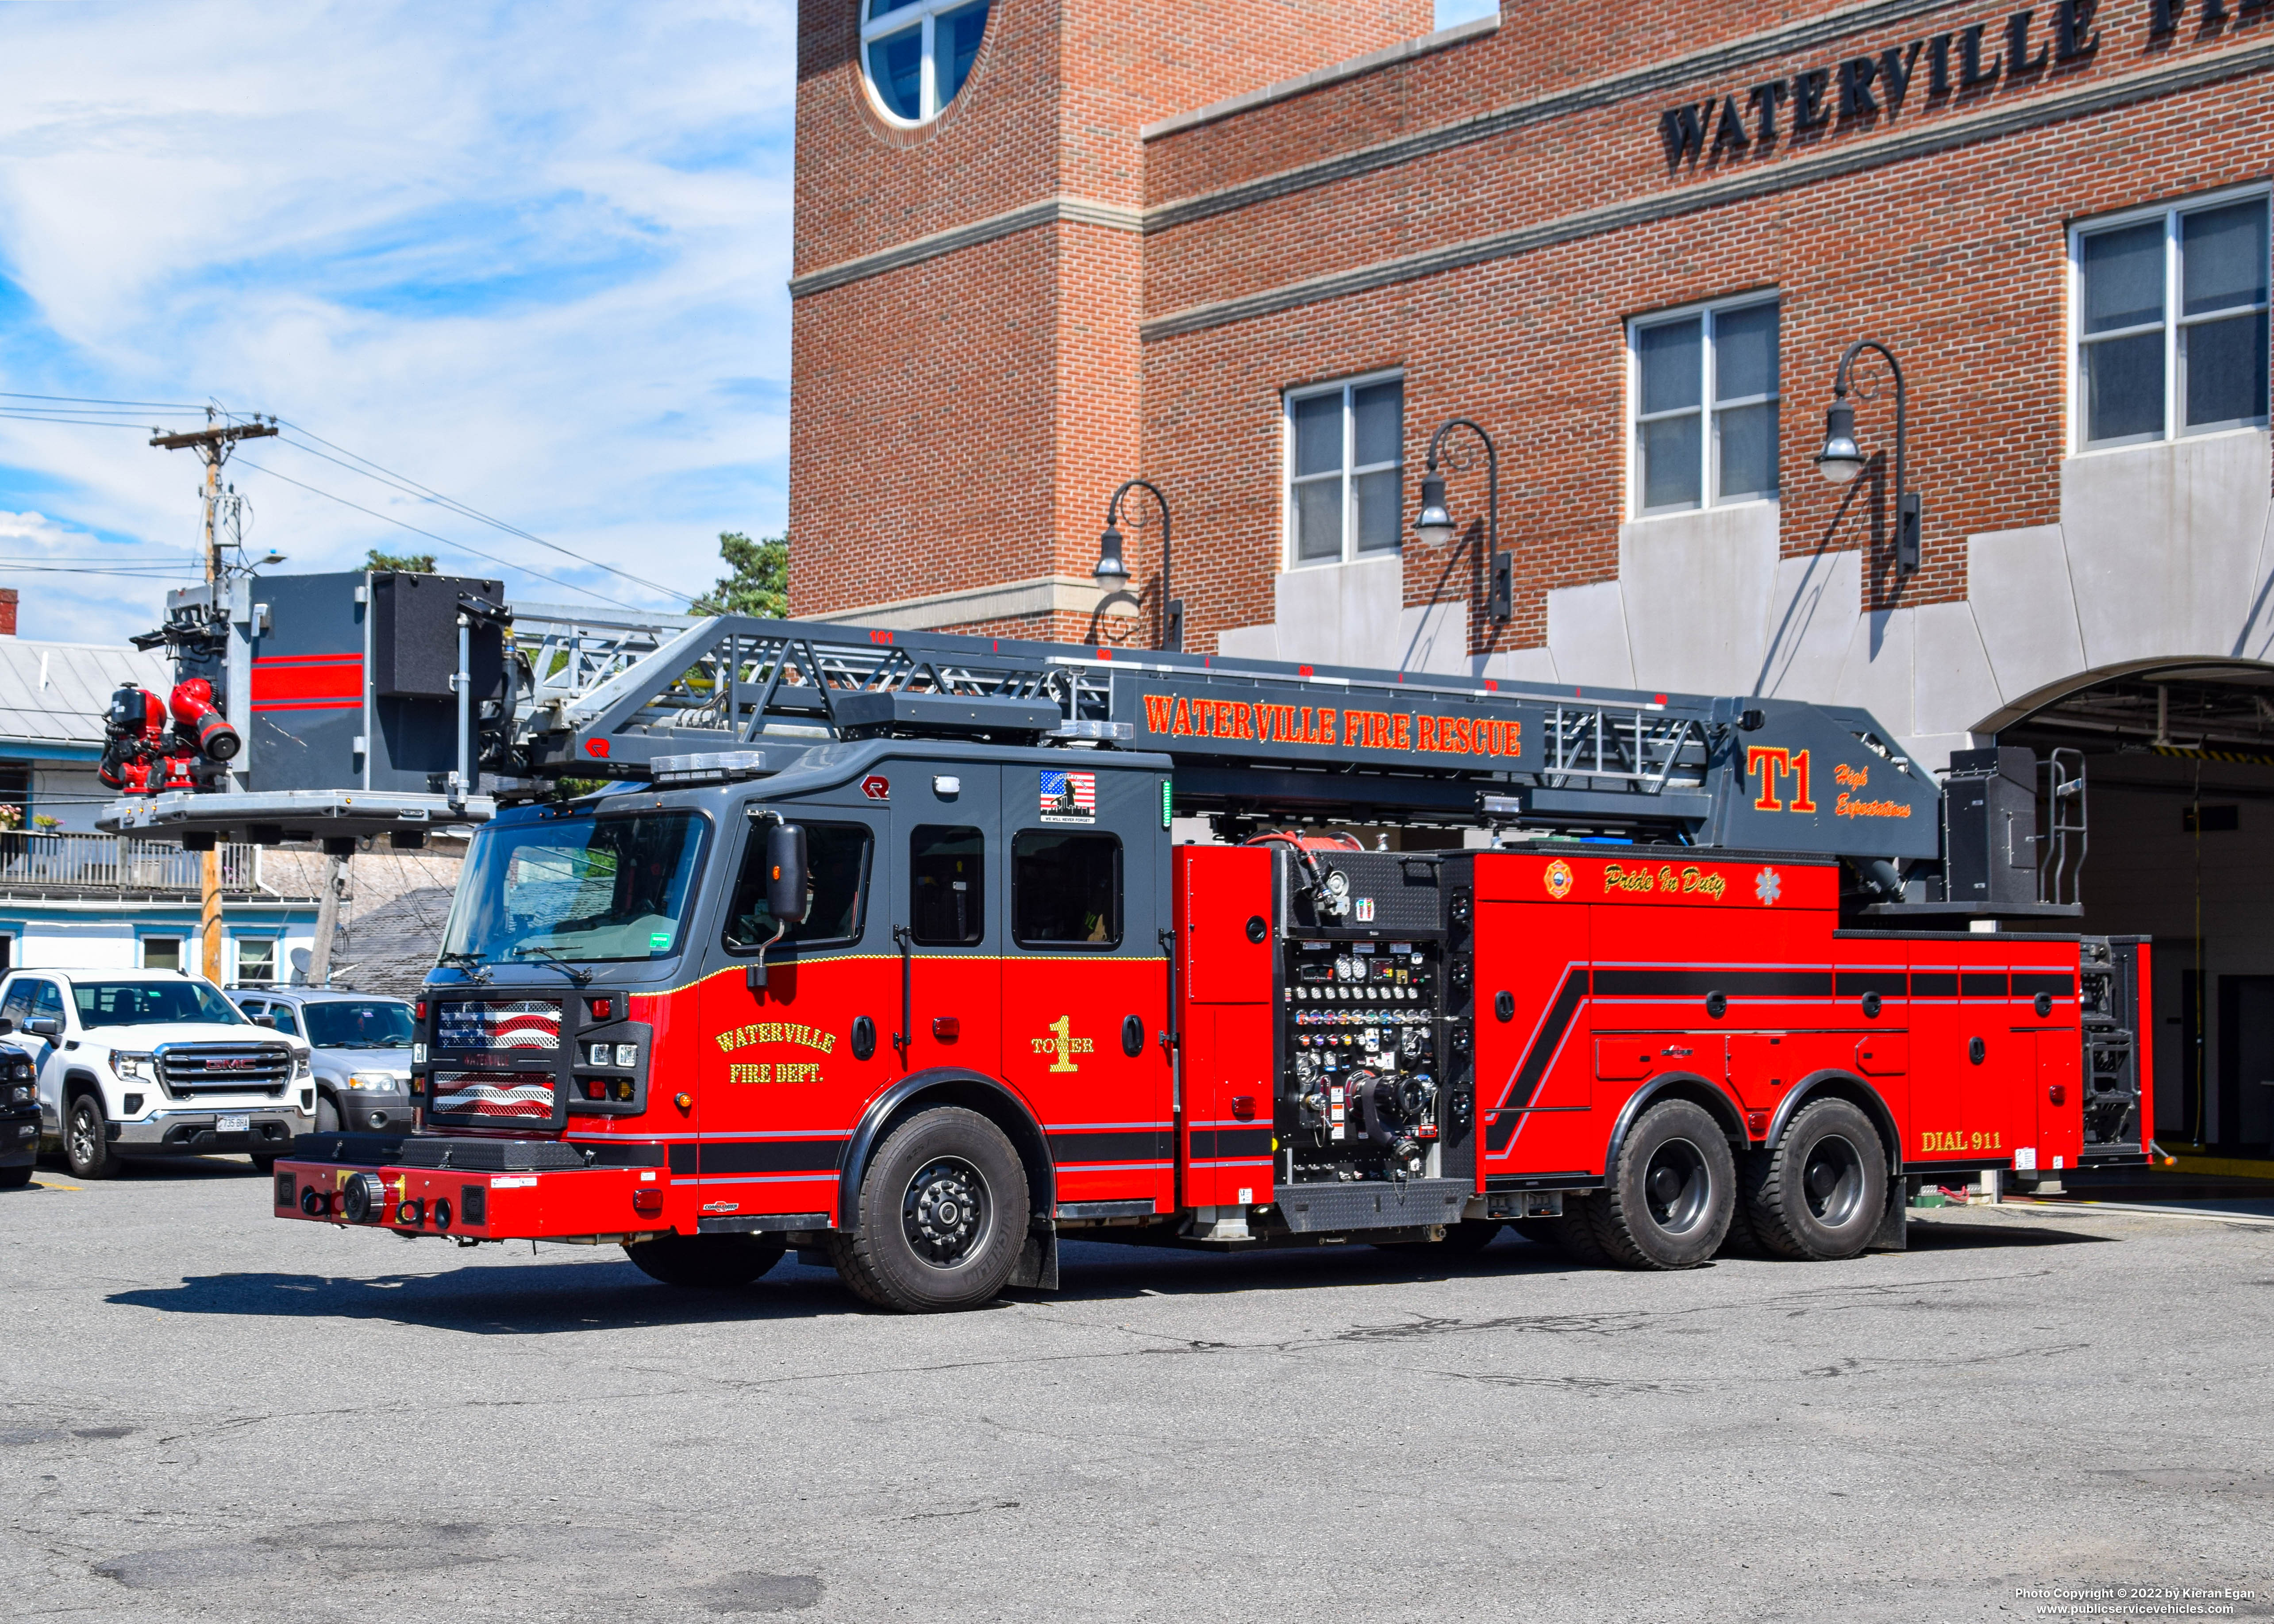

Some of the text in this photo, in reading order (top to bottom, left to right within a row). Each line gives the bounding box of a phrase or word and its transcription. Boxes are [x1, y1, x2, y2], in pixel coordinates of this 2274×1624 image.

[1661, 0, 2100, 158] WATERVILLE
[870, 630, 893, 644] 101
[1097, 649, 1112, 661] 90
[1143, 695, 1520, 757] WATERVILLE FIRE RESCUE
[1747, 745, 1816, 813] T1
[1835, 764, 1868, 791] High
[1835, 792, 1911, 819] Expectations
[1604, 864, 1725, 900] Pride In Duty
[715, 1022, 836, 1054] WATERVILLE
[1049, 1015, 1078, 1072] 1
[206, 1059, 256, 1069] GMC
[730, 1063, 823, 1083] FIRE DEPT.
[1921, 1131, 2001, 1152] DIAL 911
